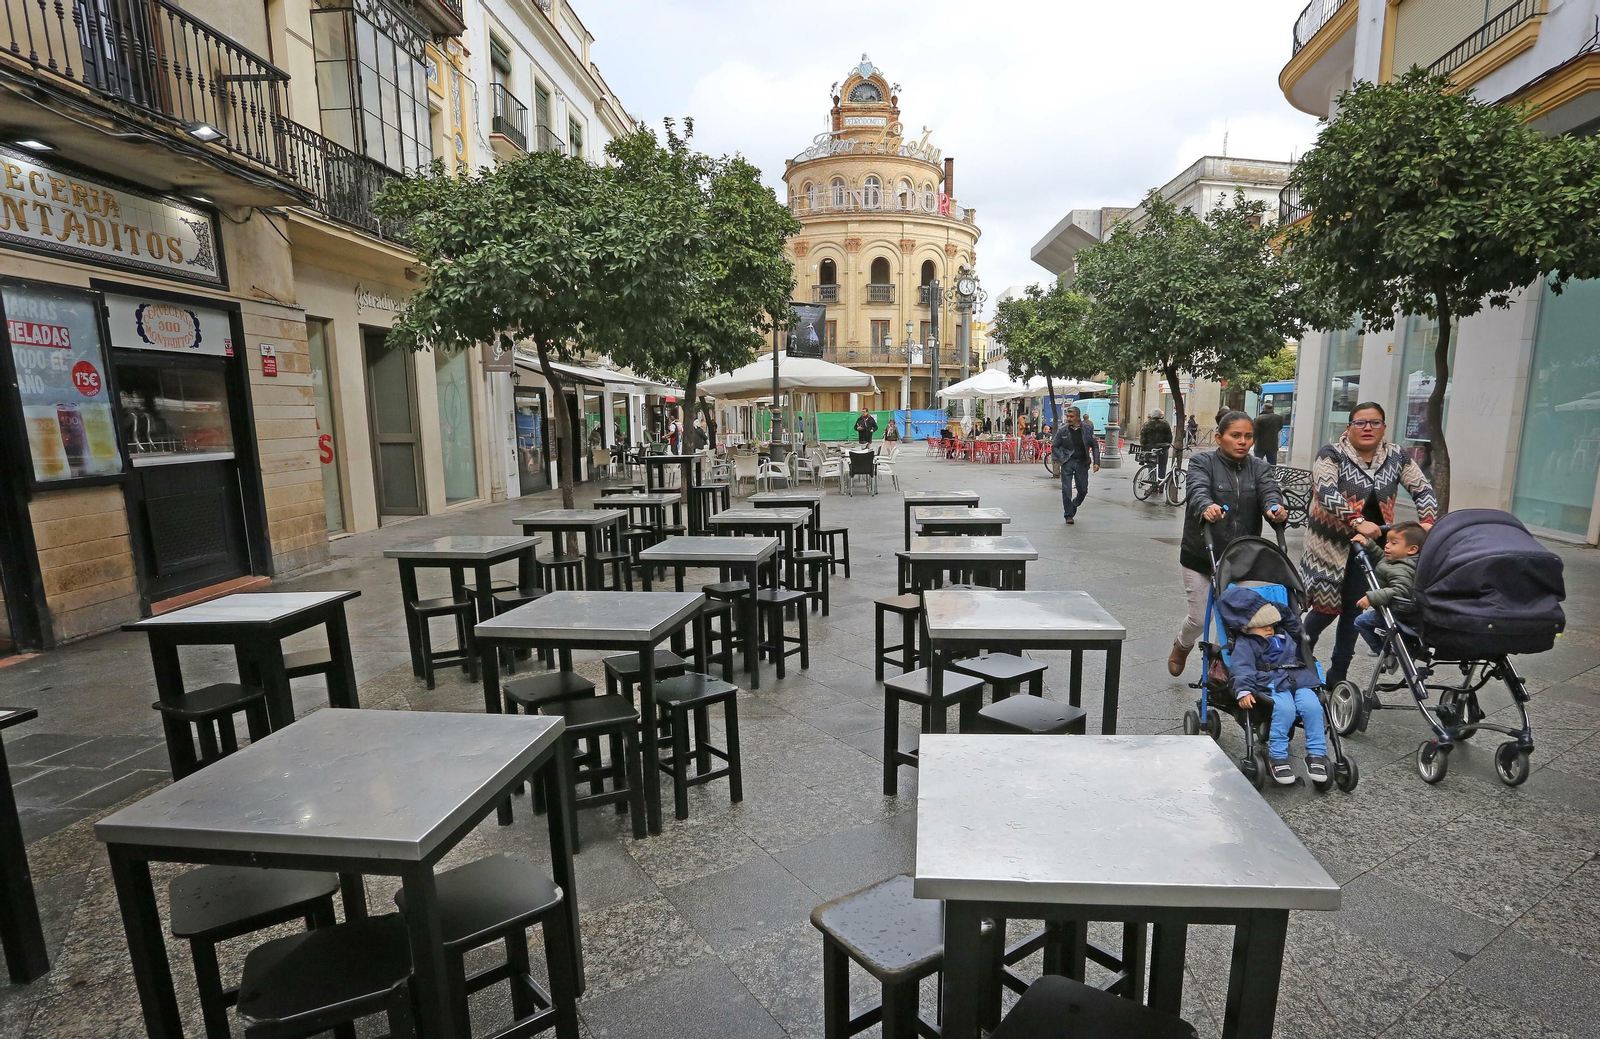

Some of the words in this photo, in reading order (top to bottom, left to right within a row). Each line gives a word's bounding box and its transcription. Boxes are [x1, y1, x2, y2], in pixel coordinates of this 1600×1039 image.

[867, 121, 905, 154] La
[809, 184, 953, 218] FUNDADOR
[0, 193, 184, 264] NTADITOS
[143, 304, 194, 330] CERVECERIA
[8, 321, 70, 347] HELADAS
[145, 324, 194, 349] MONTADITOS
